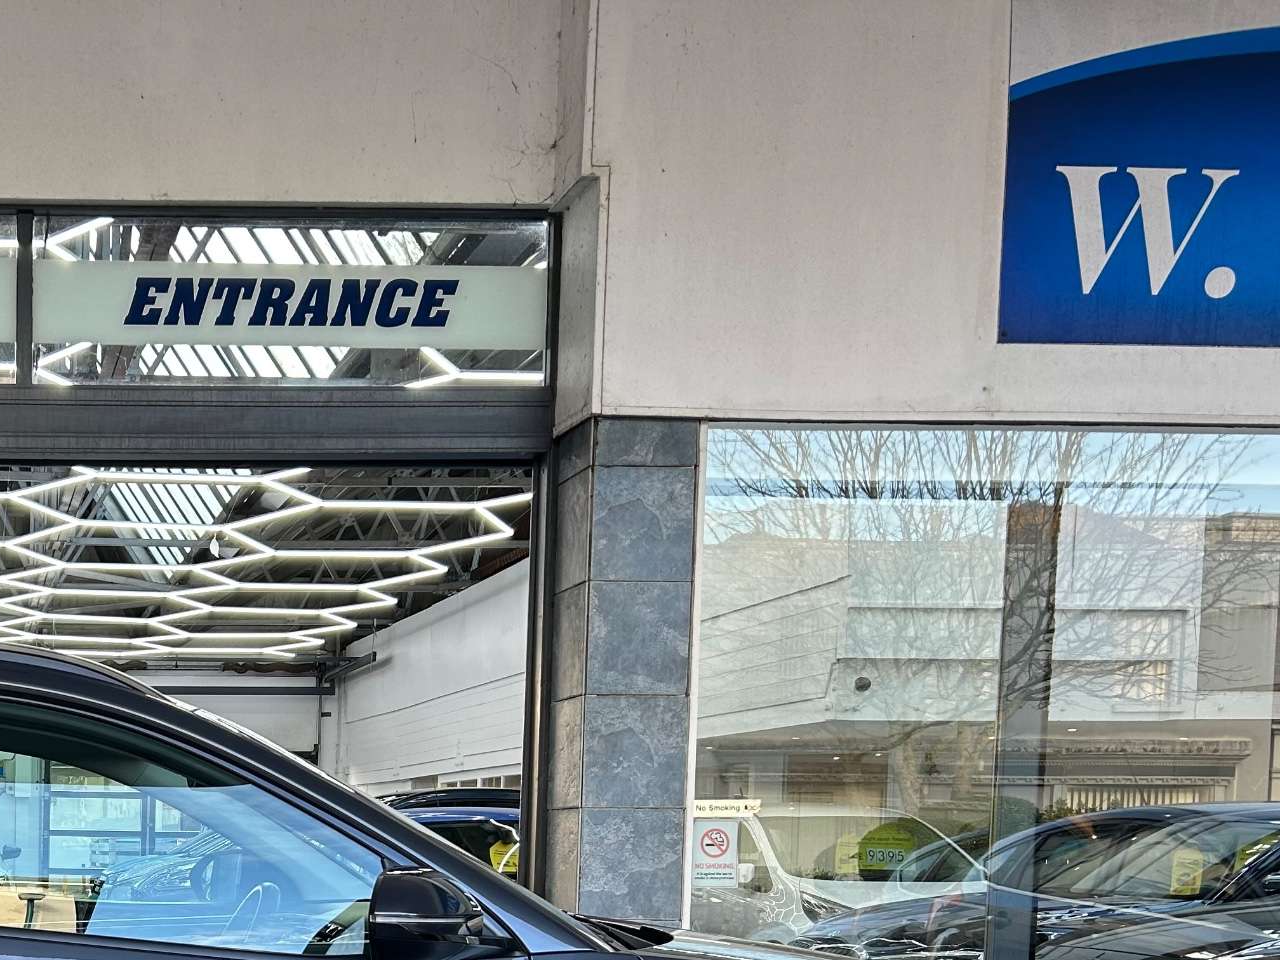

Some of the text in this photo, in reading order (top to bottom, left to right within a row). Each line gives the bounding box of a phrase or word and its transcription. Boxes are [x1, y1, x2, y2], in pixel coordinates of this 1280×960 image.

[1055, 165, 1240, 299] W.
[123, 276, 460, 328] ENTRANCE
[695, 804, 741, 813] No Smoking
[868, 849, 904, 862] 9395
